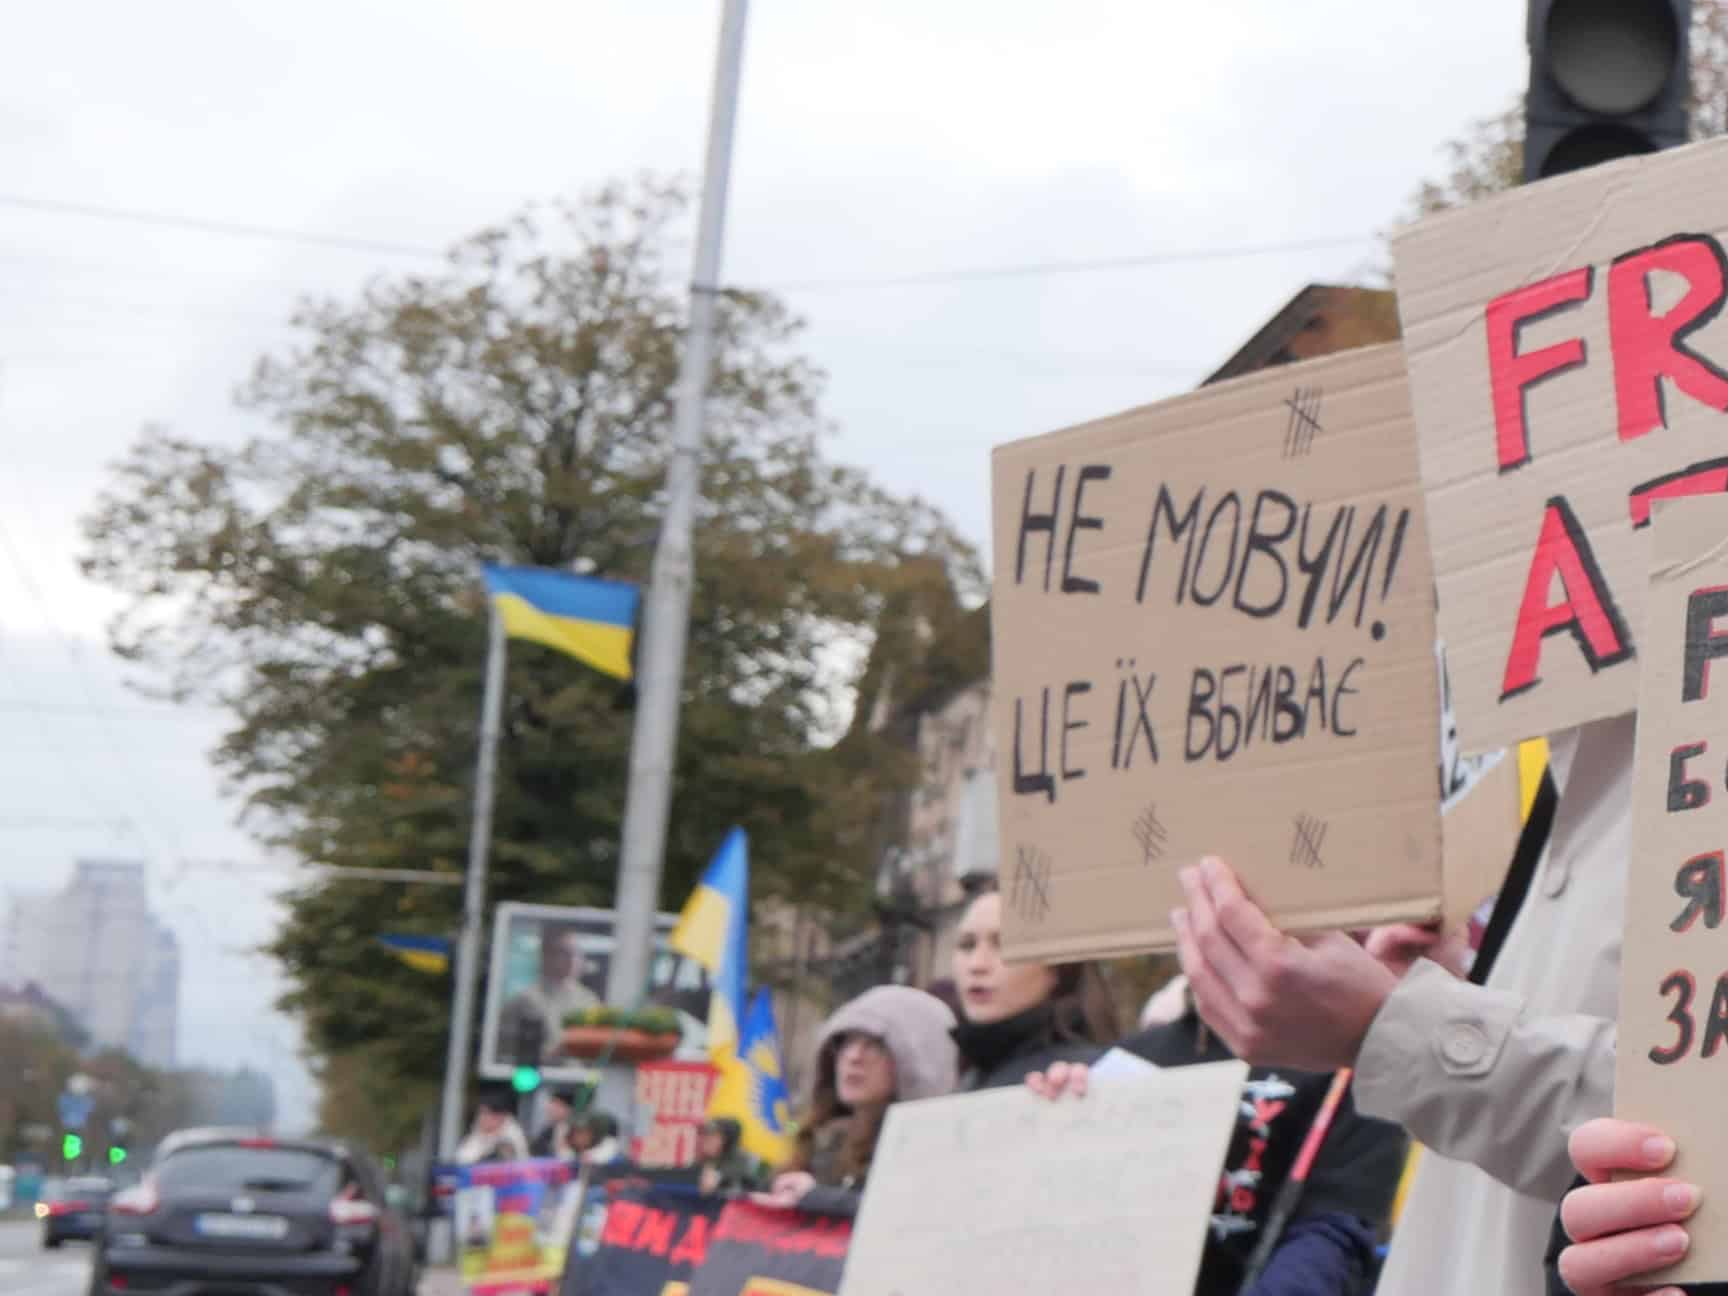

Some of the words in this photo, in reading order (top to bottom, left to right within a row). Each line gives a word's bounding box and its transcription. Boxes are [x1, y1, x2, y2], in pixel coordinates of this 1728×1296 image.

[1015, 464, 1111, 594] НЕ
[1136, 481, 1411, 641] МОВЧИ!
[1012, 682, 1093, 804] ЦЕ
[1111, 658, 1160, 771] ЇХ
[1184, 656, 1366, 763] ВБИВАЄ
